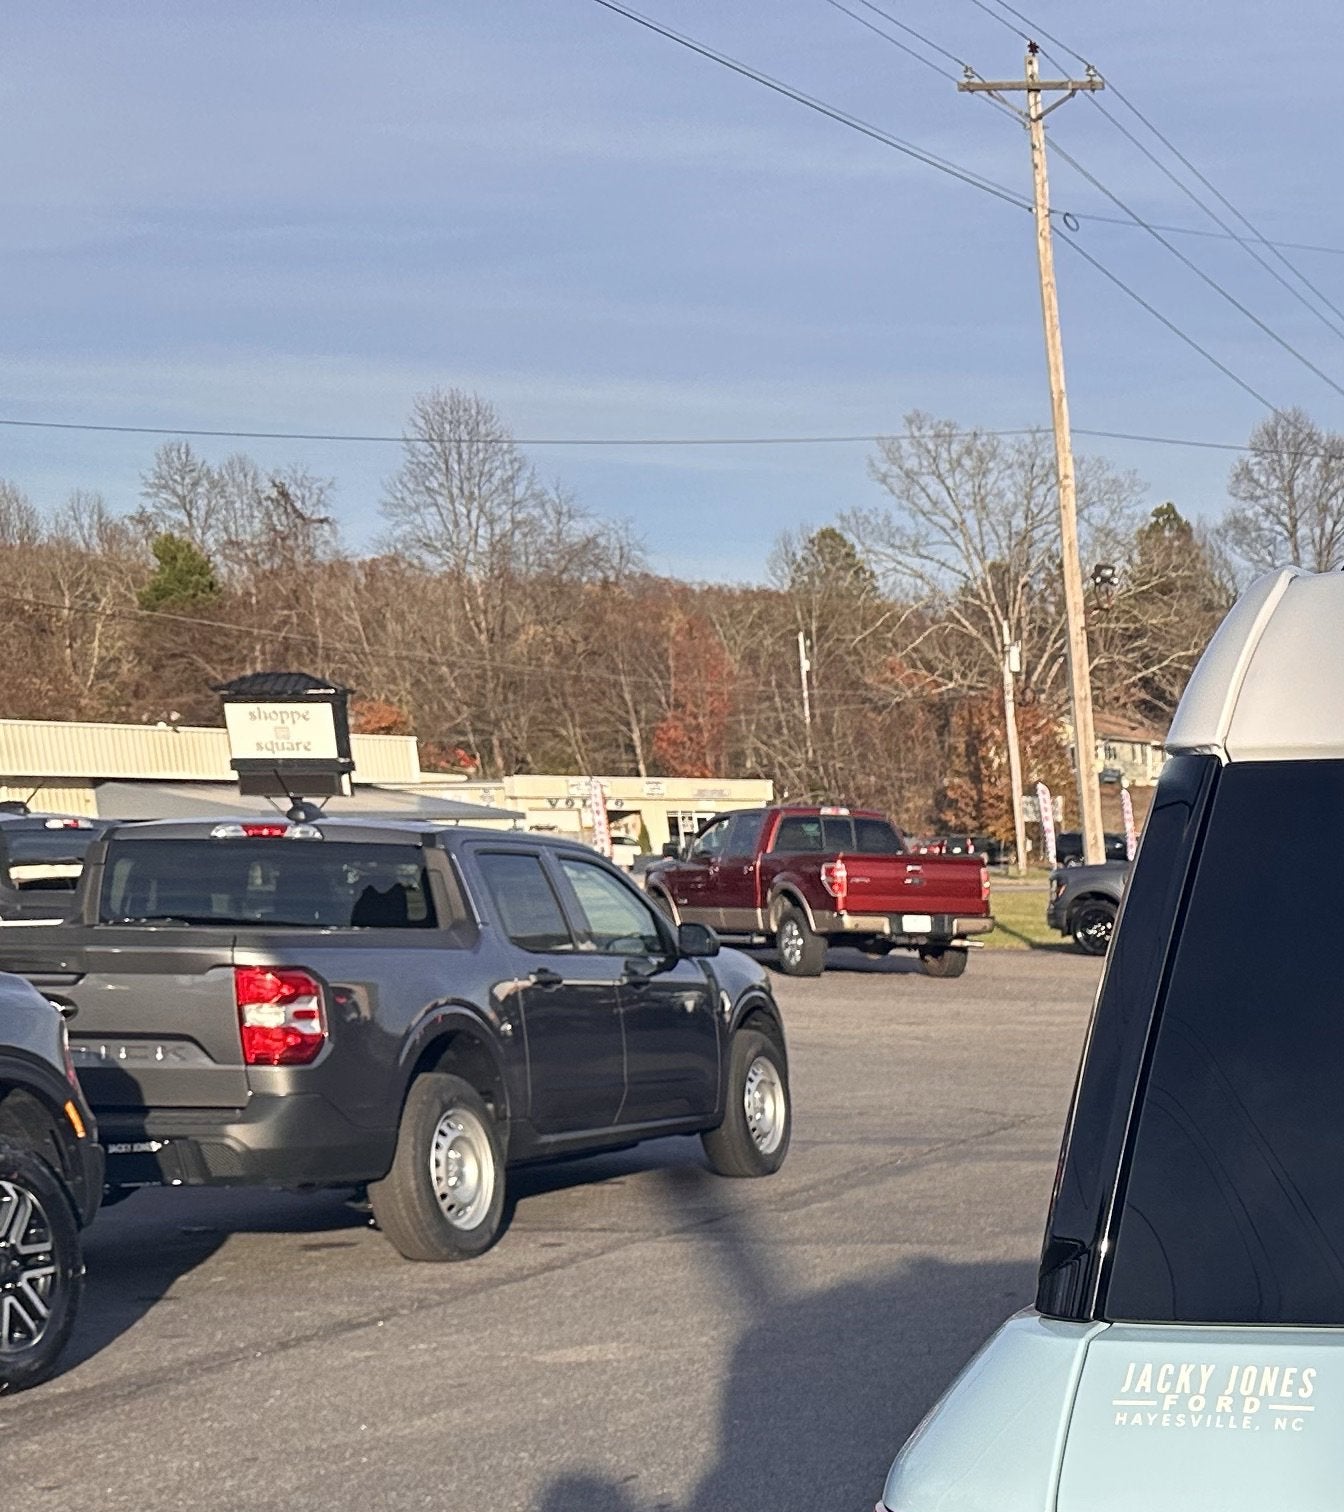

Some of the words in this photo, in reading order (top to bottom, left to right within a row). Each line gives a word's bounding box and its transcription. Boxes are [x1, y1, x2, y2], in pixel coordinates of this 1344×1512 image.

[248, 707, 311, 725] shoppe
[255, 740, 312, 754] square
[547, 798, 625, 809] VOLO
[1121, 1362, 1216, 1395] JACKY
[1224, 1365, 1317, 1399] JONES
[1163, 1395, 1261, 1414] FORD
[1114, 1412, 1261, 1431] HAYESVILLE,
[1274, 1417, 1305, 1432] NC
